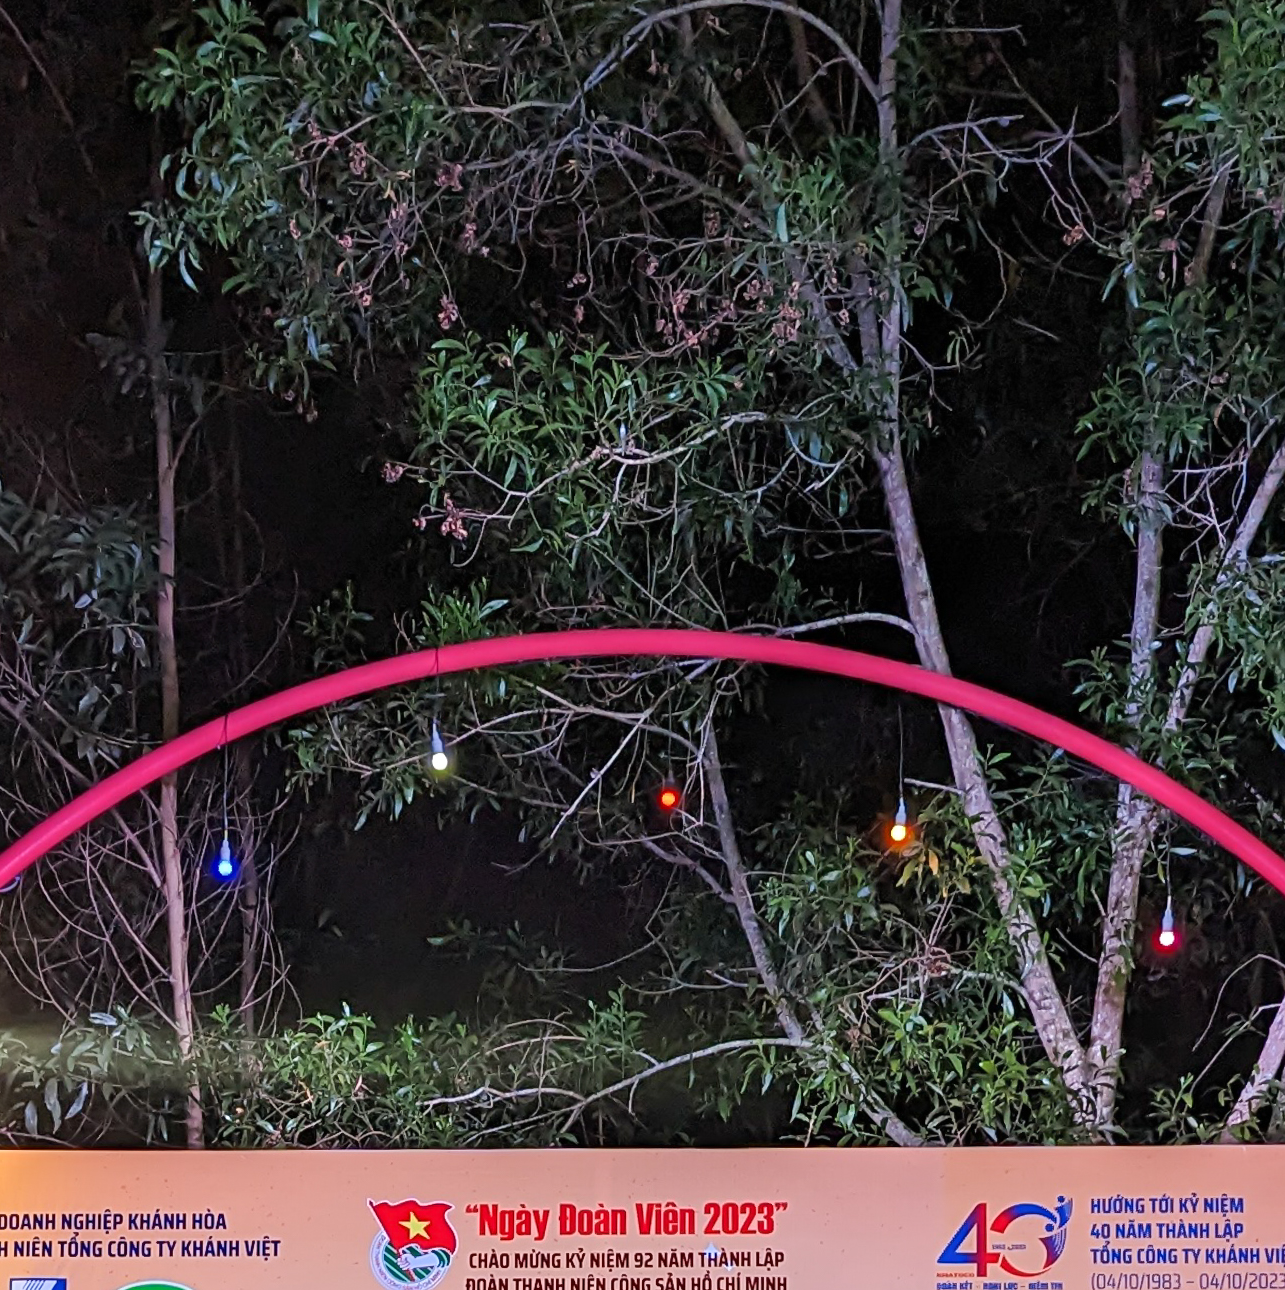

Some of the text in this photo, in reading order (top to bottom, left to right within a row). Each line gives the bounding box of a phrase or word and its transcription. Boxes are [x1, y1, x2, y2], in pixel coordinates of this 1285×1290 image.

[1090, 1192, 1244, 1217] HƯỚNG TỚI KỶ NIỆM
[61, 1208, 124, 1234] NGHIỆP
[128, 1208, 187, 1230] KHÁNH
[192, 1208, 227, 1230] HÒA
[558, 1203, 627, 1236] Đoàn
[635, 1201, 696, 1236] Viên
[1090, 1218, 1244, 1243] 40 NĂM THÀNH LẬP
[14, 1236, 52, 1258] NIÊN
[57, 1232, 103, 1258] TỔNG
[107, 1236, 152, 1258] CÔNG
[156, 1240, 177, 1258] TY
[181, 1235, 240, 1257] KHÁNH
[244, 1235, 281, 1261] VIỆT
[1090, 1240, 1133, 1264] TỔNG
[1137, 1244, 1178, 1264] CÔNG
[1181, 1248, 1201, 1264] TY
[1205, 1243, 1260, 1264] KHÁNH
[469, 1247, 785, 1272] CHÀO MỪNG KỶ NIỆM 92 NĂM THÀNH LẬP
